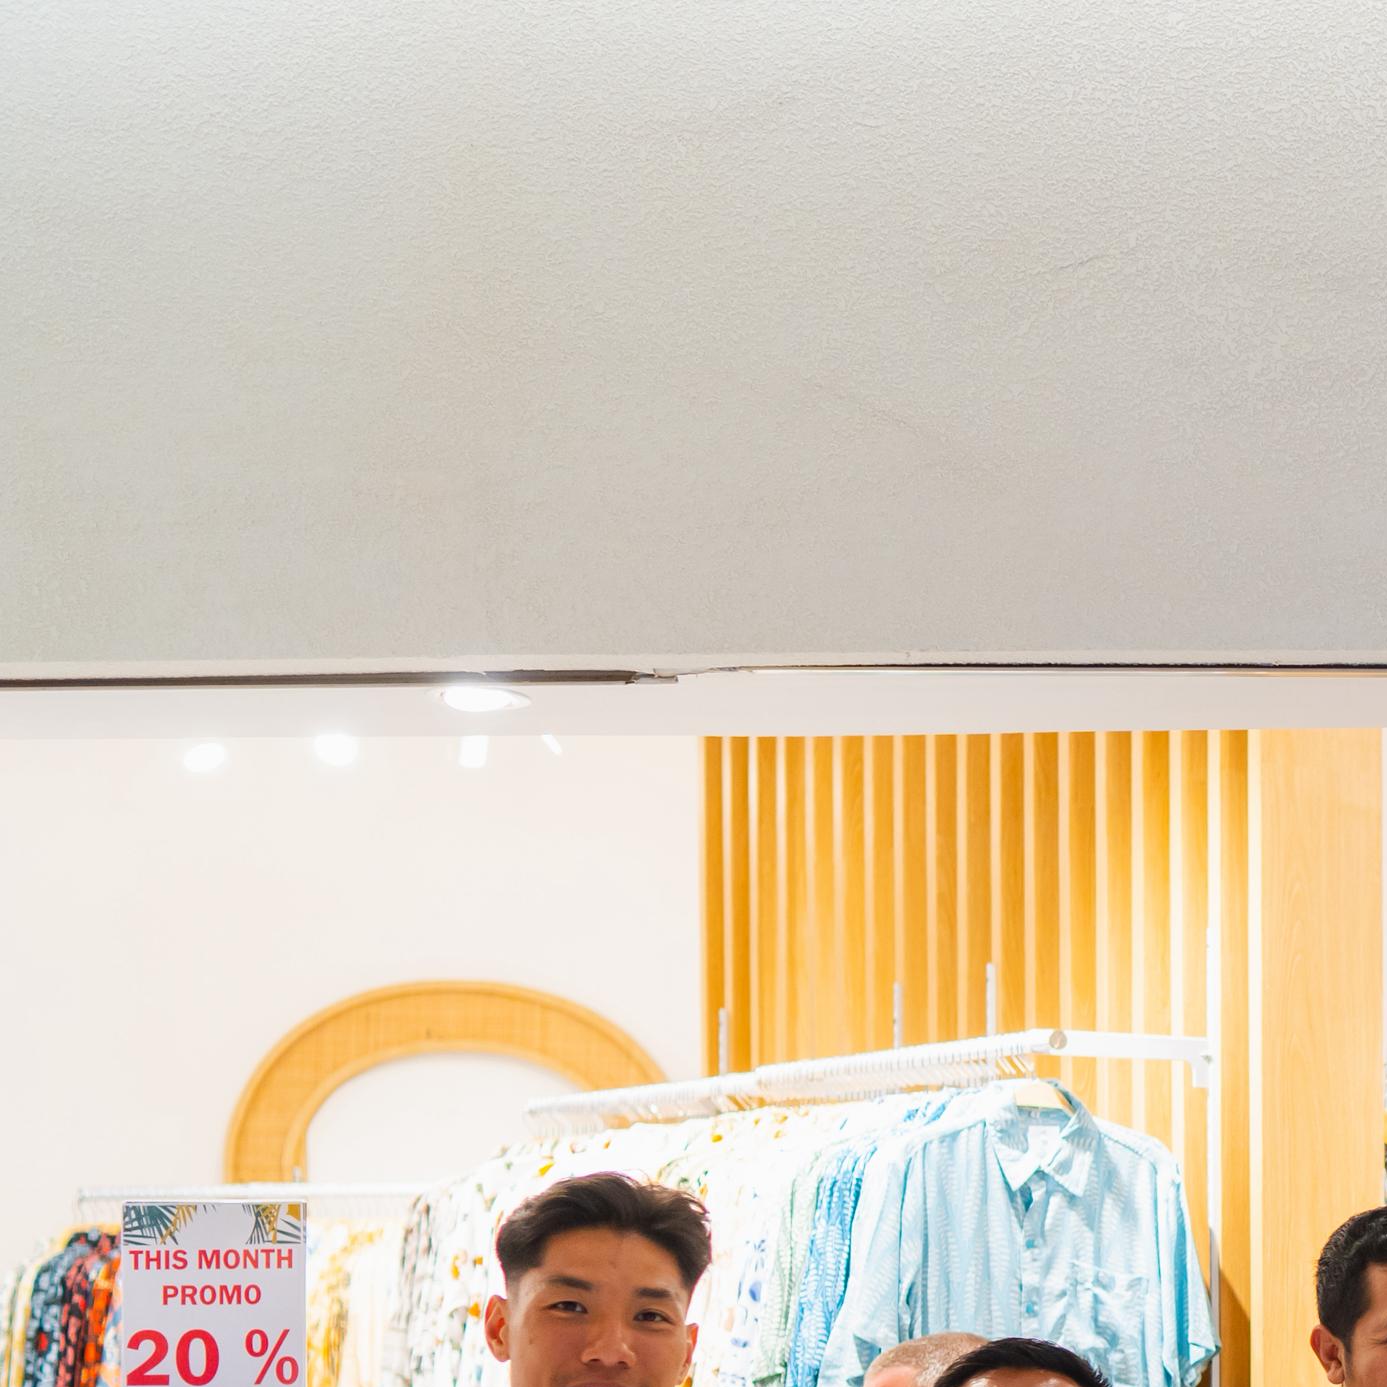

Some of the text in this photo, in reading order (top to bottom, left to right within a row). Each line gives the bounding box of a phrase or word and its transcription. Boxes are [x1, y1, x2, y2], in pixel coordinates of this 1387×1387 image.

[129, 1248, 293, 1271] THIS MONTH
[161, 1283, 262, 1306] PROMO
[126, 1328, 299, 1386] 20 %
